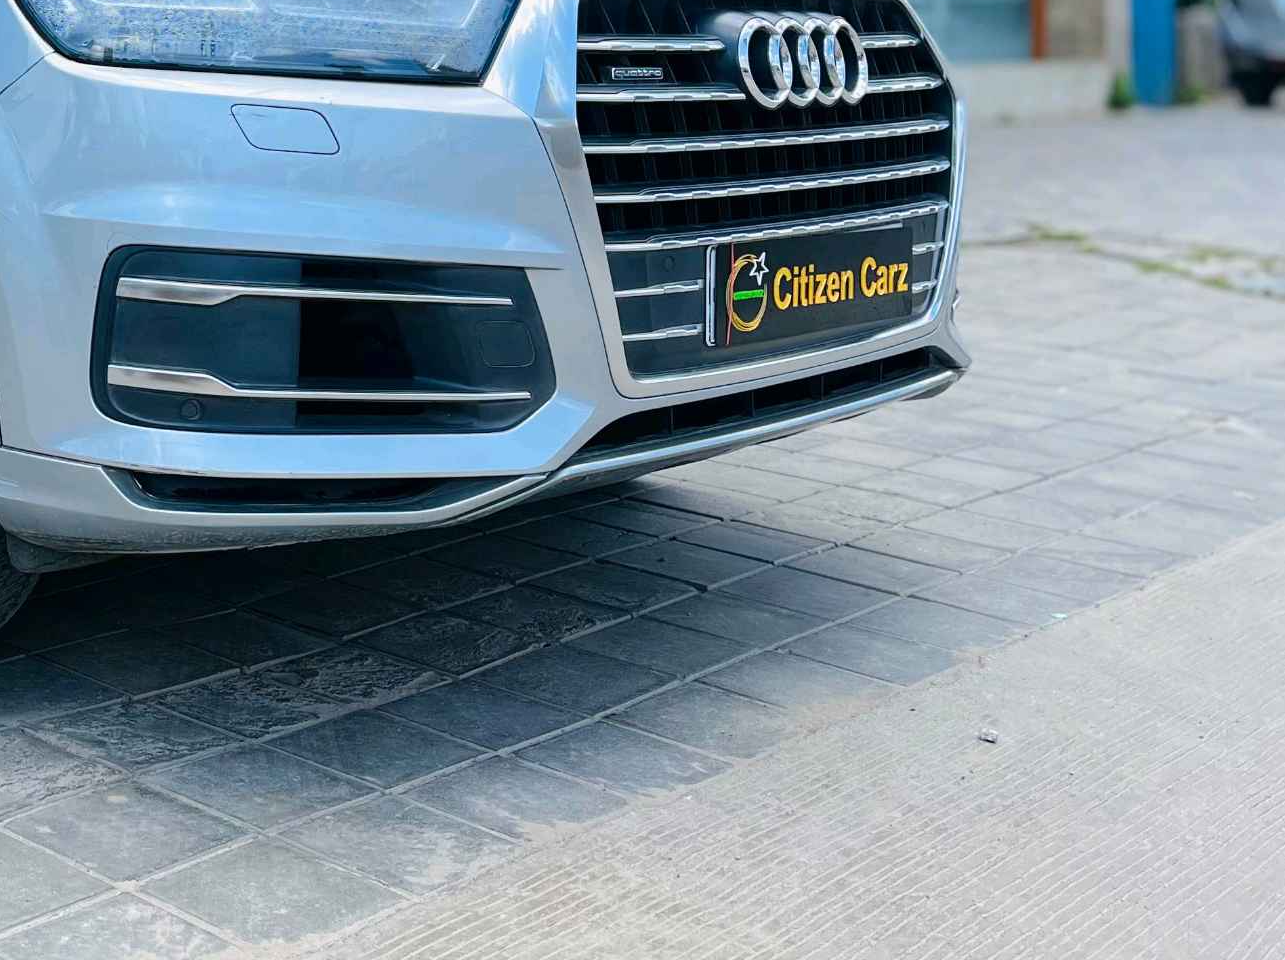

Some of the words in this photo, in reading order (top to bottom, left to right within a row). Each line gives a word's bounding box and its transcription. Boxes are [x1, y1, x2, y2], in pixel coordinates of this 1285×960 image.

[613, 68, 663, 80] quattro
[773, 263, 855, 311] Citizen
[860, 256, 909, 298] Carz
